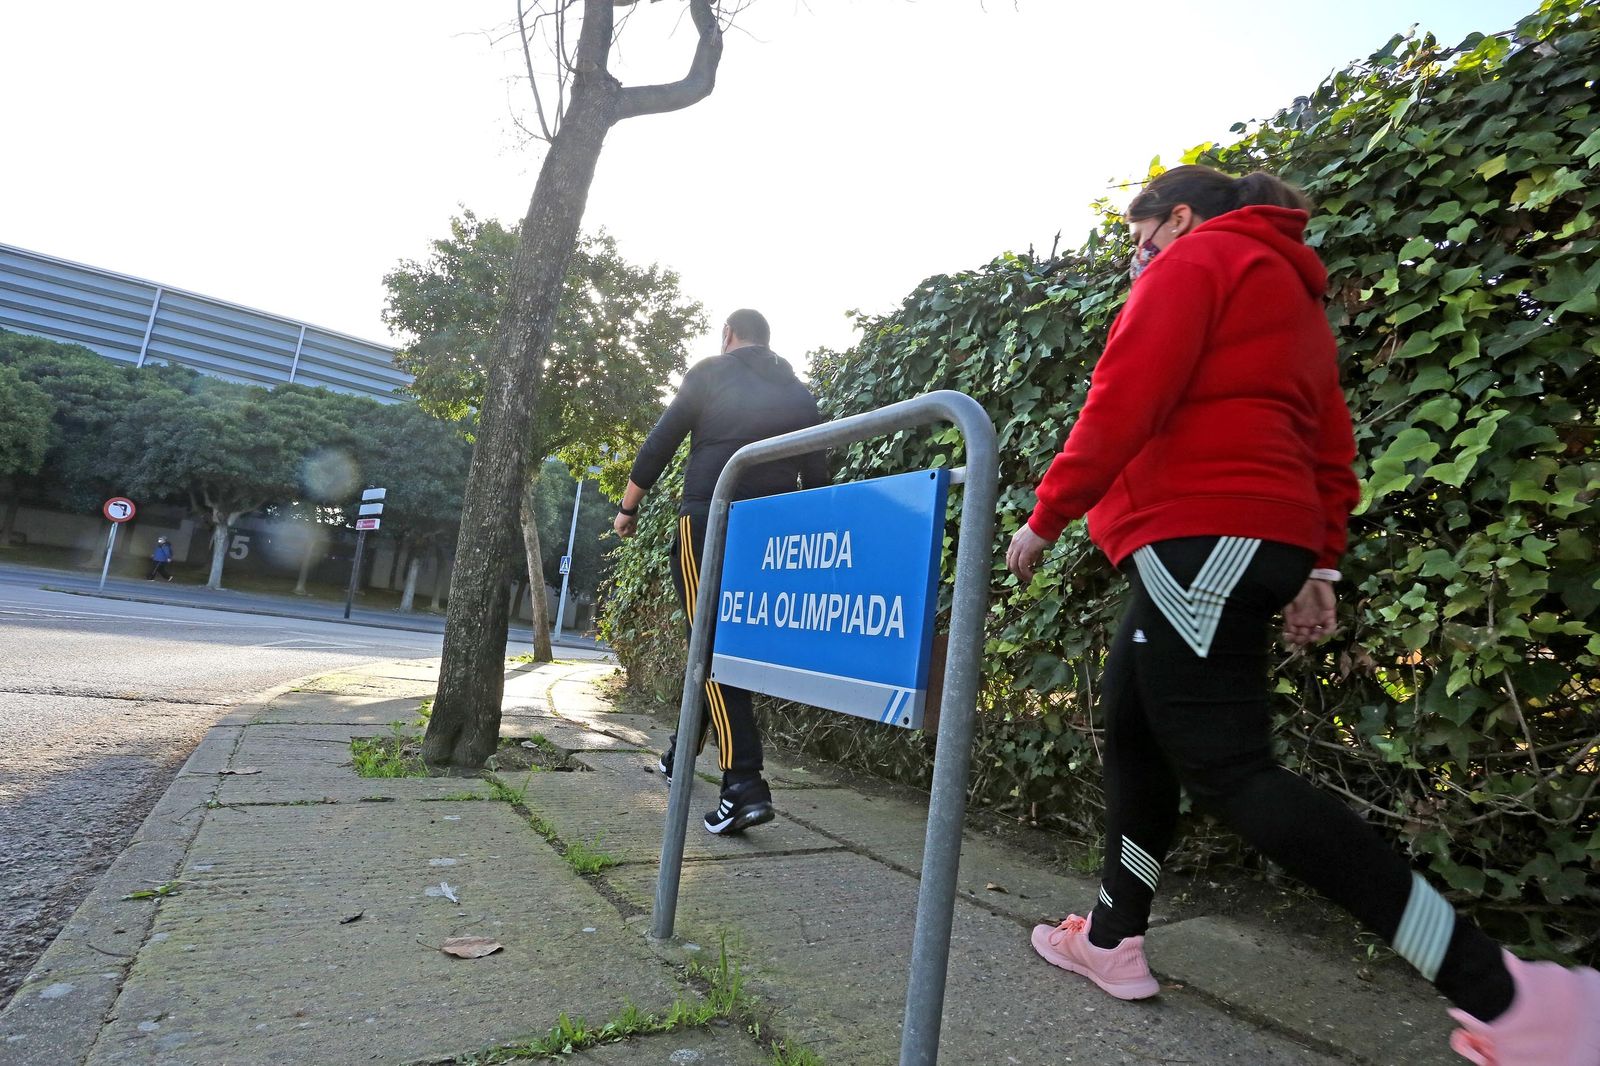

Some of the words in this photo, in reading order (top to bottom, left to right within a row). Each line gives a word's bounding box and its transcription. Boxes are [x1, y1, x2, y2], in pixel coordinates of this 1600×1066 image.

[761, 530, 852, 570] AVENIDA
[720, 591, 744, 623] DE
[746, 592, 768, 625] LA
[774, 591, 905, 638] OLIMPIADA
